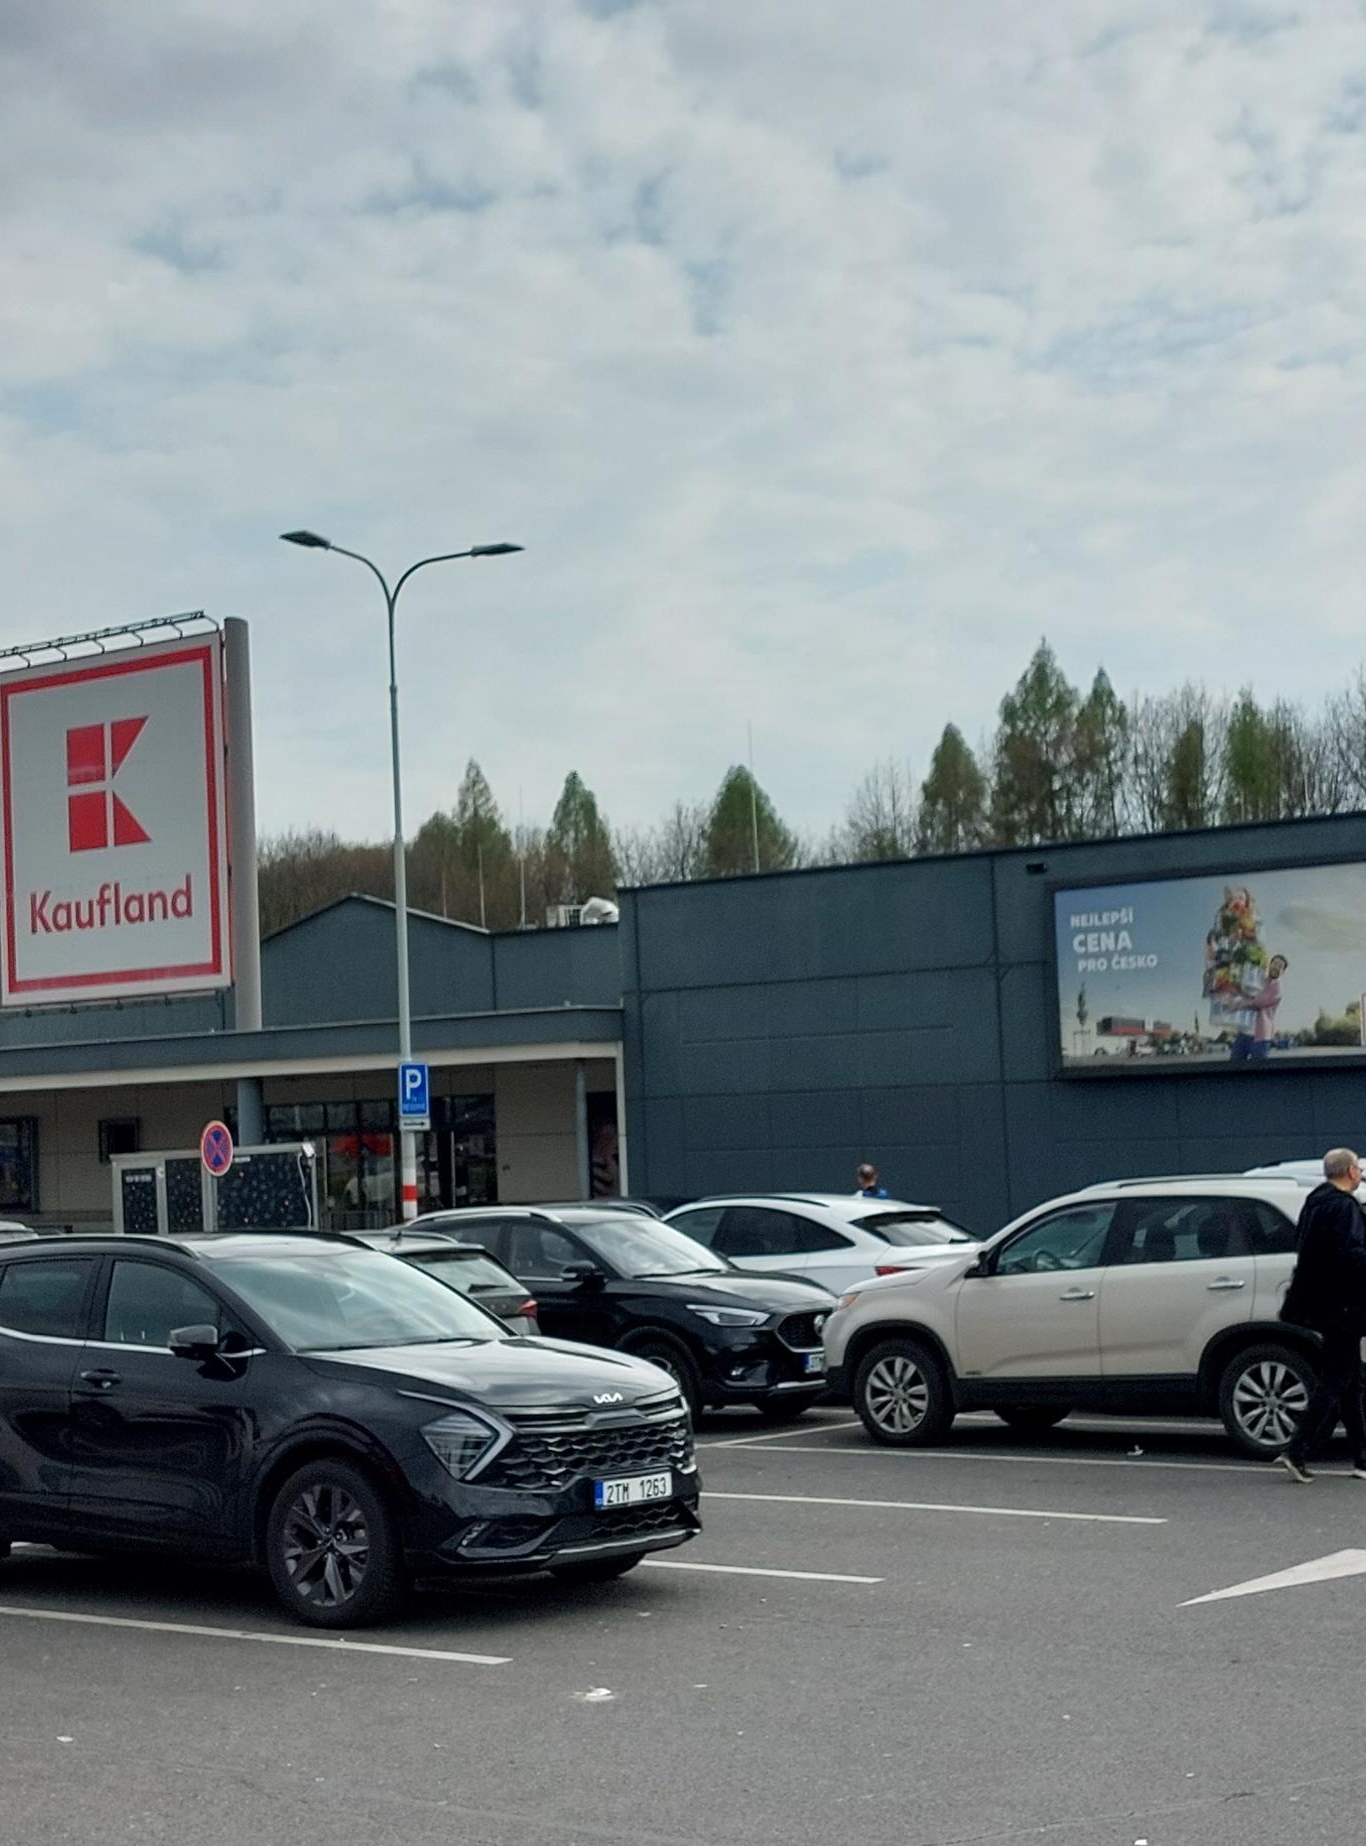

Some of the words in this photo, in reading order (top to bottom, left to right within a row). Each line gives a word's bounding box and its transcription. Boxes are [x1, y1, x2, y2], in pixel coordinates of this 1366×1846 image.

[66, 715, 152, 853] K
[30, 873, 193, 934] Kaufland
[1070, 907, 1134, 929] NEJLEPŠÍ
[1072, 930, 1132, 954] CENA
[1077, 958, 1107, 973] PRO
[1110, 953, 1158, 972] ČESKO
[405, 1068, 422, 1100] P
[606, 1482, 630, 1504] 2TM
[639, 1476, 667, 1499] 1263
